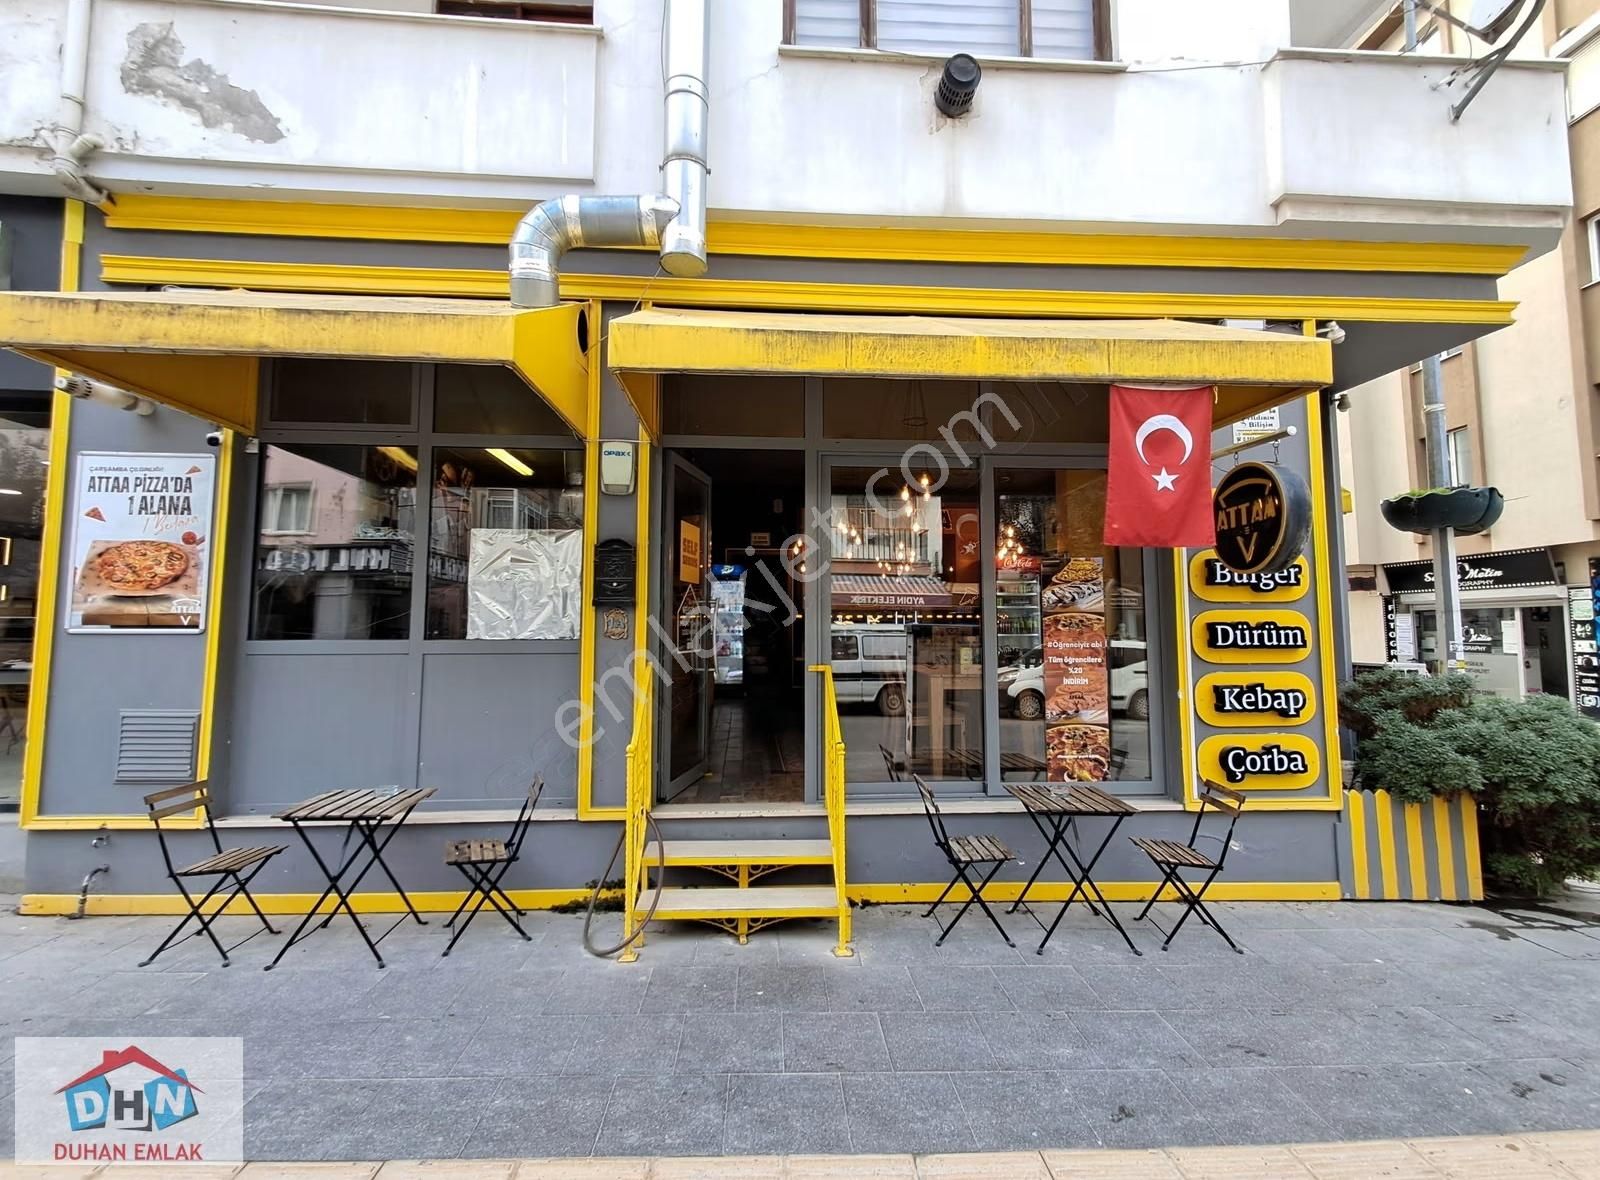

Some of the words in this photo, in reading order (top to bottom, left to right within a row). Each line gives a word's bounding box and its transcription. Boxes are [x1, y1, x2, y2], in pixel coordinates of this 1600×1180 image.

[87, 476, 130, 493] ATTAA
[133, 473, 193, 493] PİZZA'DA
[128, 496, 135, 515] 1
[138, 496, 192, 516] ALANA
[1459, 579, 1494, 587] OGRAPHY
[1216, 624, 1304, 646] Dürüm
[1223, 687, 1304, 715] Kebap
[1228, 748, 1305, 780] Çorba
